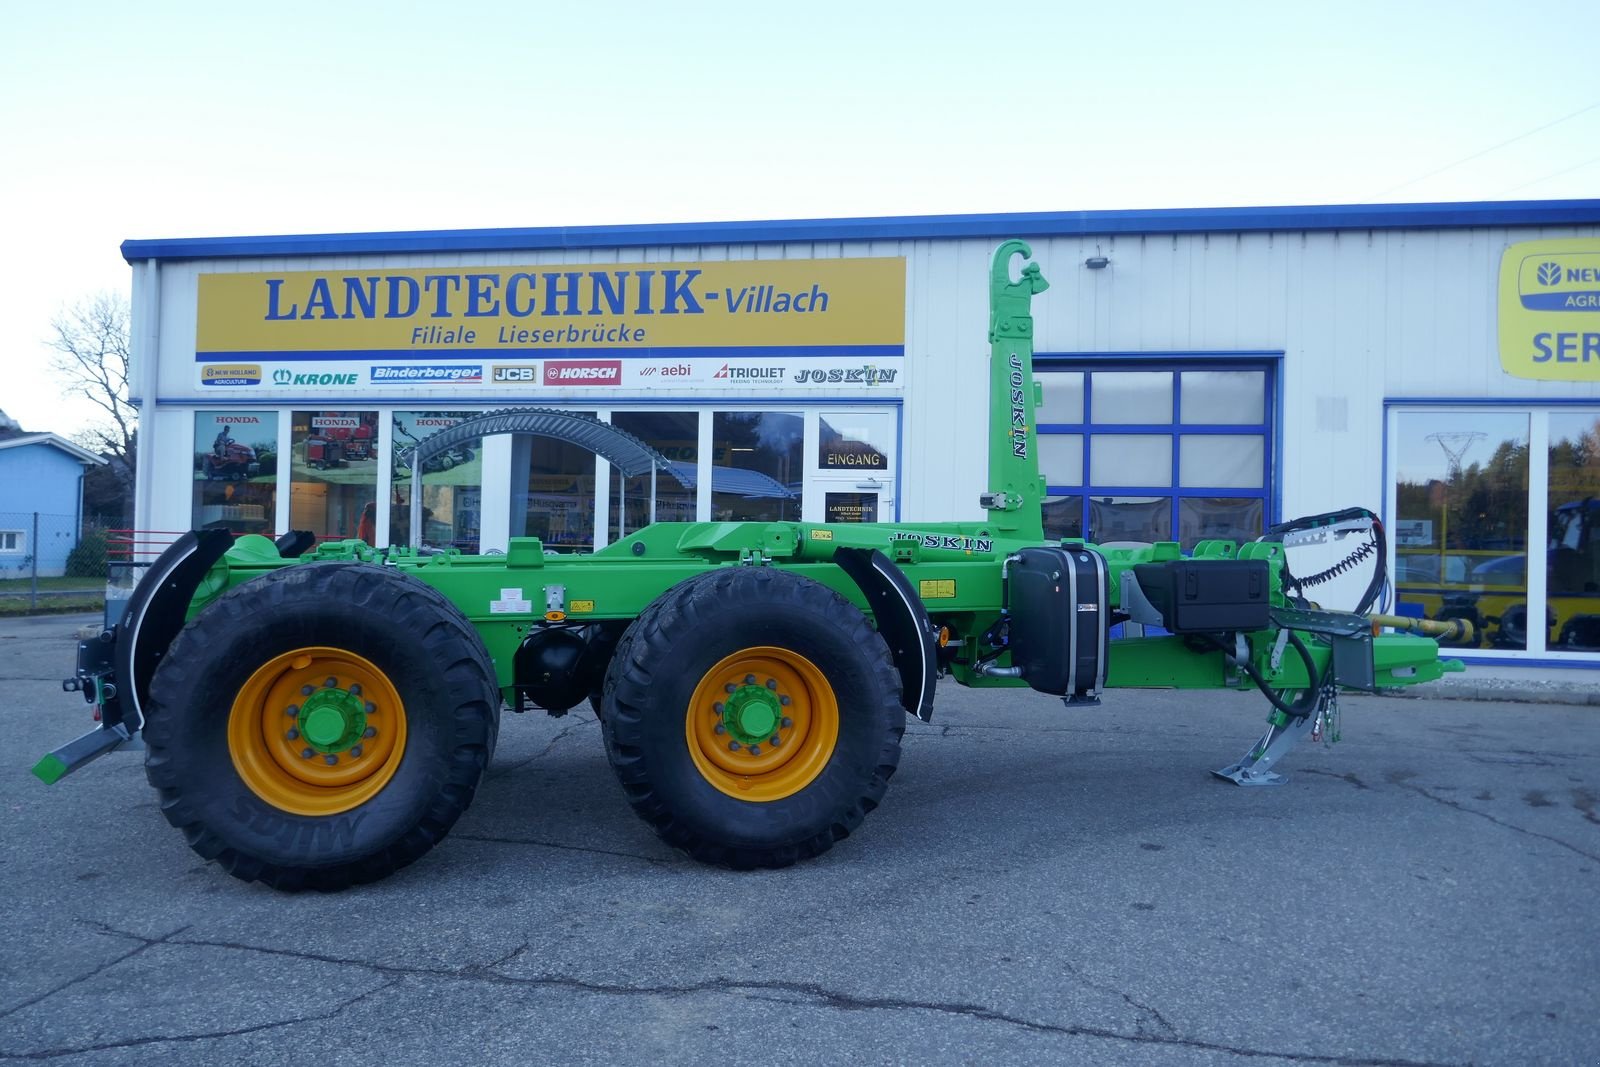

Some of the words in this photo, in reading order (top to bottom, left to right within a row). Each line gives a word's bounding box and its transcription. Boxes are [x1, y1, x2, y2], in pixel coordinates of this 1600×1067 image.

[411, 325, 476, 344] Filiale
[498, 323, 646, 344] Lieserbrücke
[373, 367, 480, 379] Binderberger
[494, 368, 534, 380] JCB
[560, 367, 617, 379] HORSCH
[661, 364, 691, 376] aebi
[728, 368, 786, 378] TRIOLIET
[794, 367, 898, 385] JOSKIN
[293, 374, 359, 385] KRONE
[1008, 353, 1028, 460] JOSKIN
[215, 416, 260, 424] HONDA
[314, 417, 358, 427] HONDA
[827, 453, 880, 466] EINGANG
